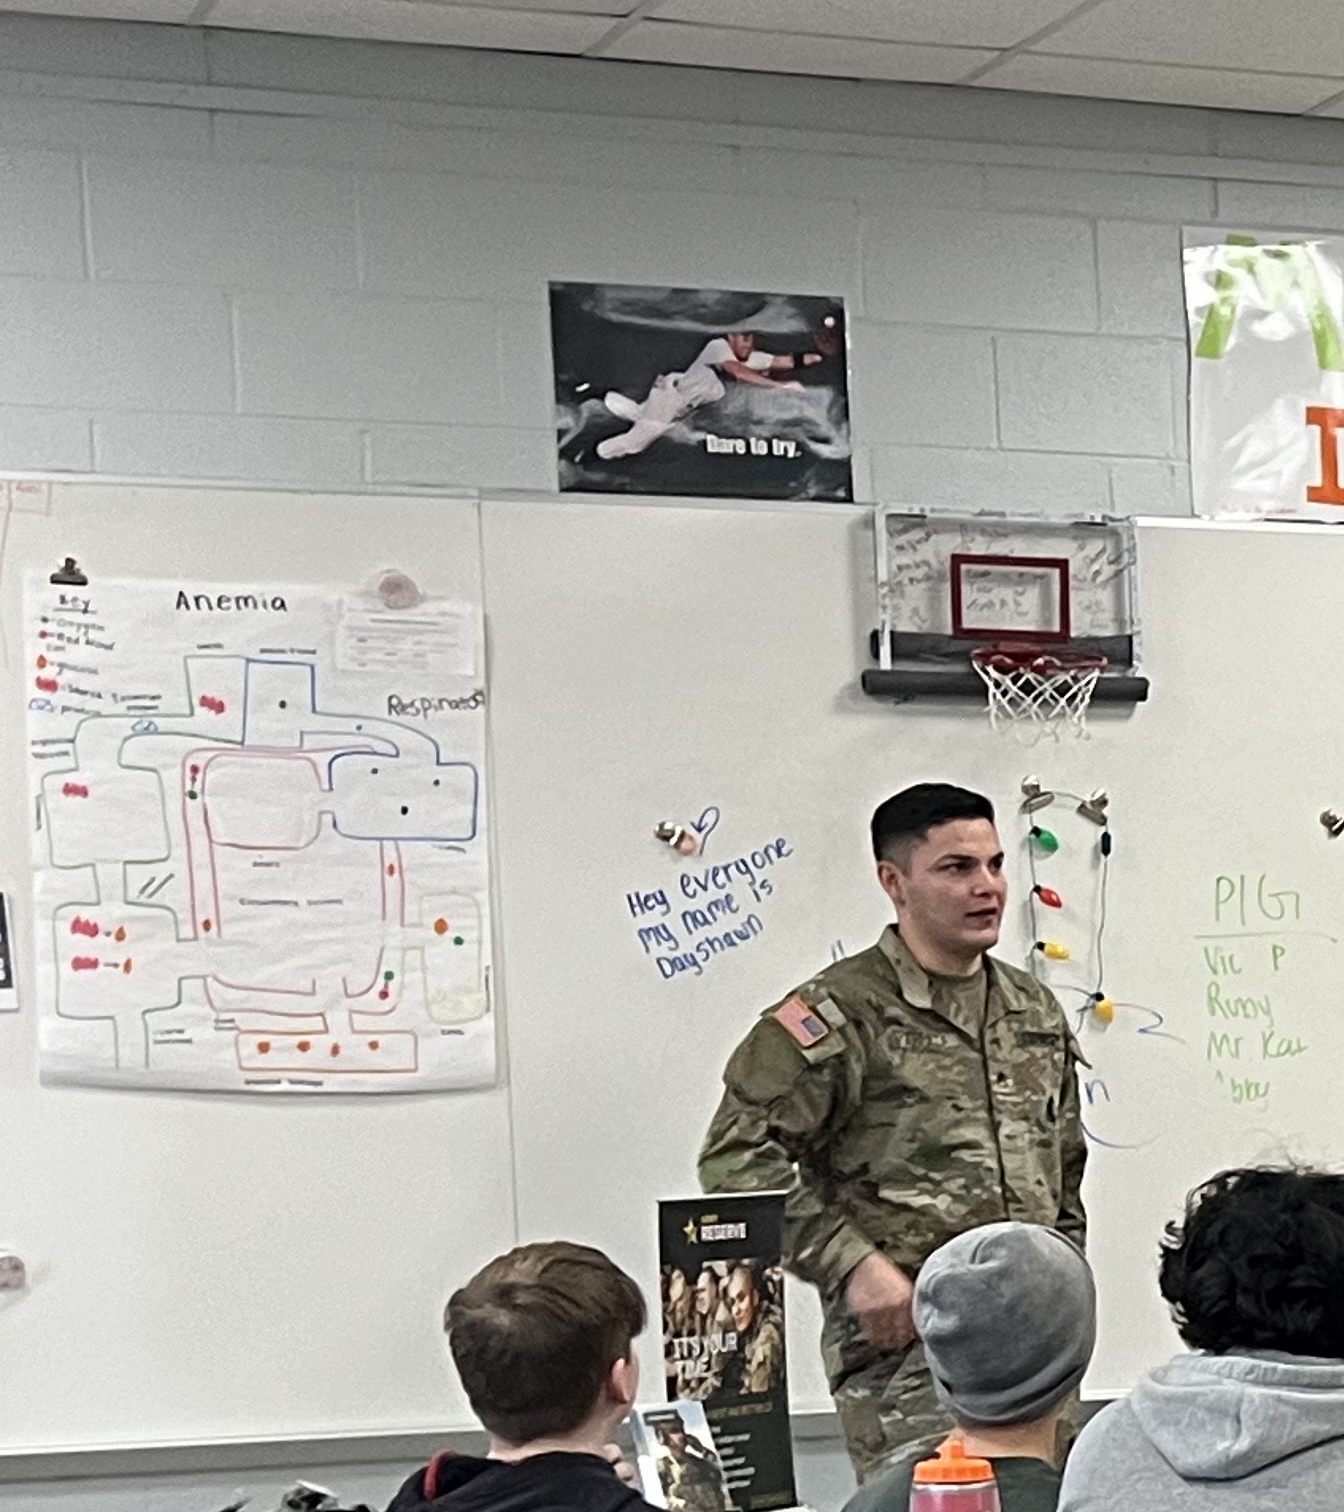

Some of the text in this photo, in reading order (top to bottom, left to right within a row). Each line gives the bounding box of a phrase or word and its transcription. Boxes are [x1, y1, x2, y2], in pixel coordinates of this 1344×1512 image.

[749, 437, 768, 455] to
[175, 589, 288, 613] Anemia
[626, 837, 793, 918] Hey everyone
[637, 878, 773, 954] my name is
[1271, 943, 1286, 972] P
